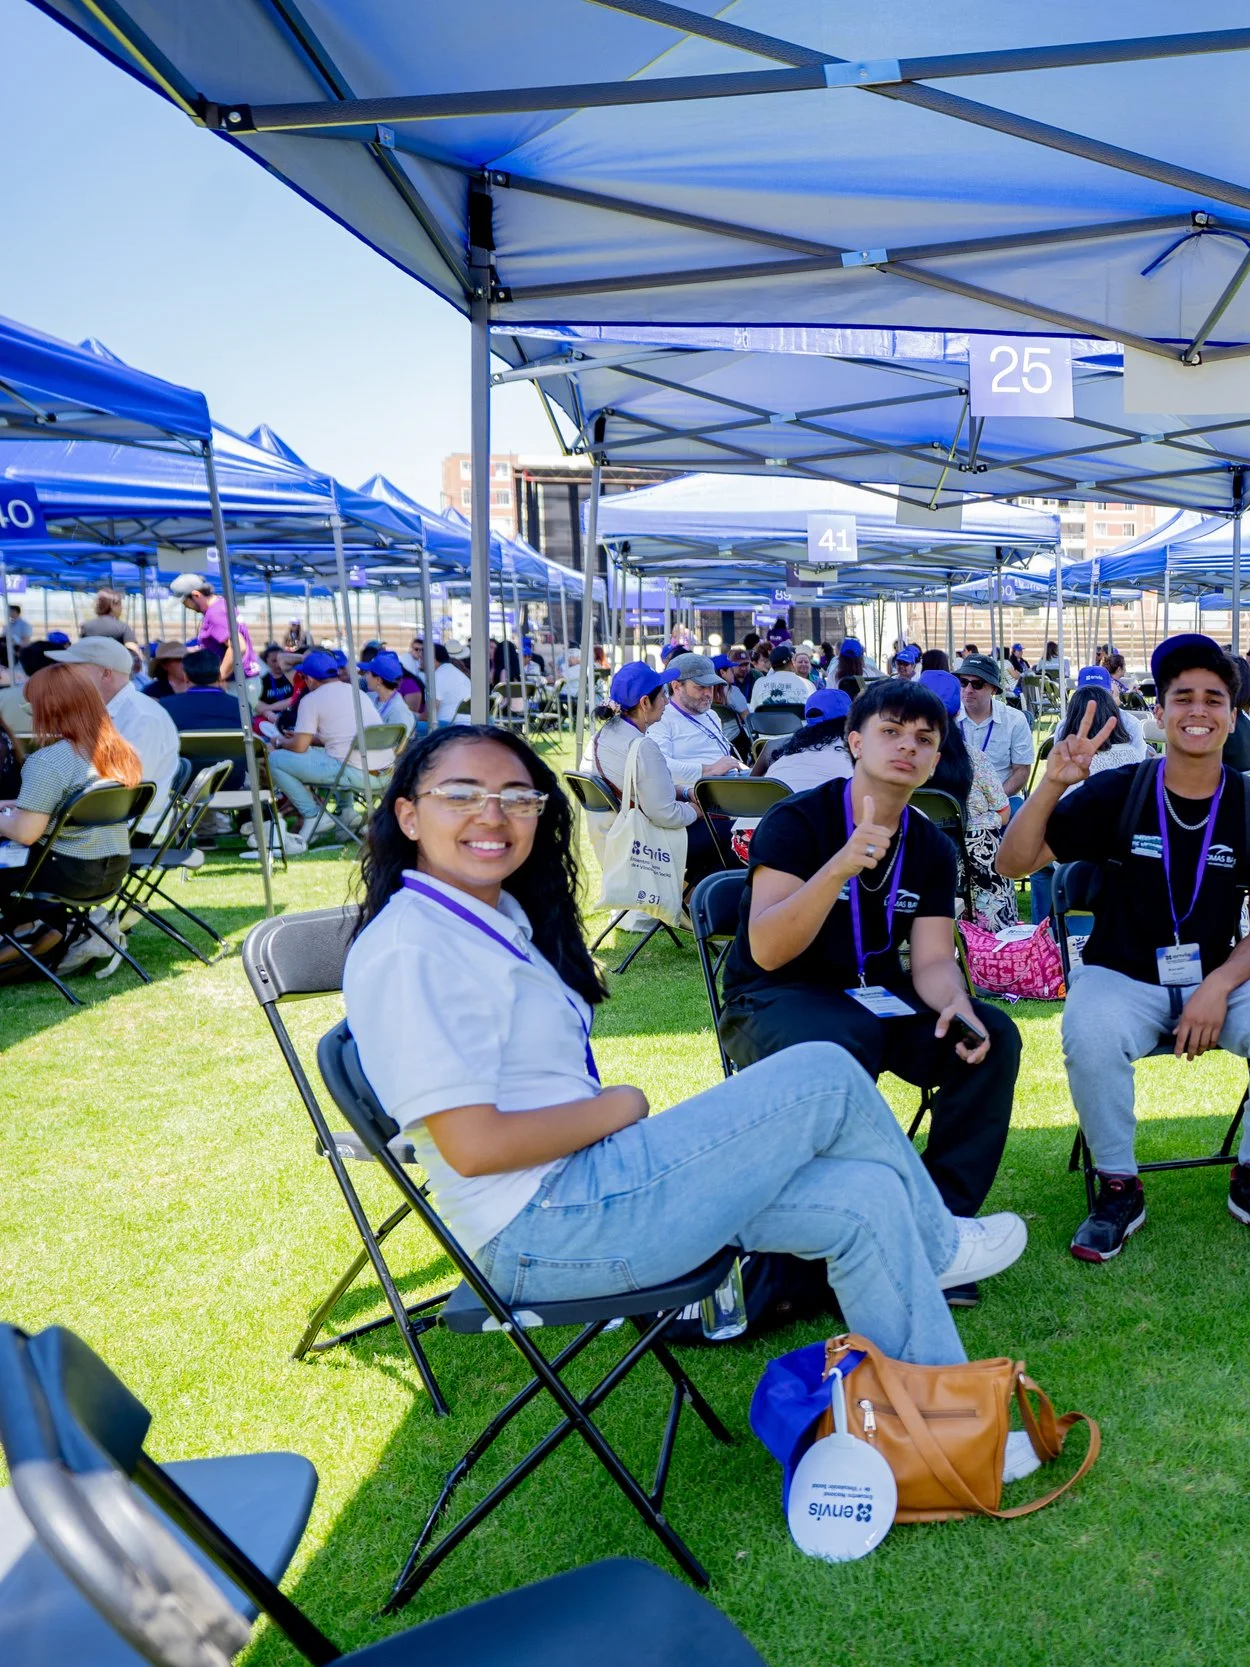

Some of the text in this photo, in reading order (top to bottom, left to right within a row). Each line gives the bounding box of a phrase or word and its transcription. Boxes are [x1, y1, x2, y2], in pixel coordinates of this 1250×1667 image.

[989, 345, 1053, 394] 25
[818, 528, 852, 552] 41
[1205, 854, 1226, 863] OMAS
[808, 1502, 854, 1521] envis
